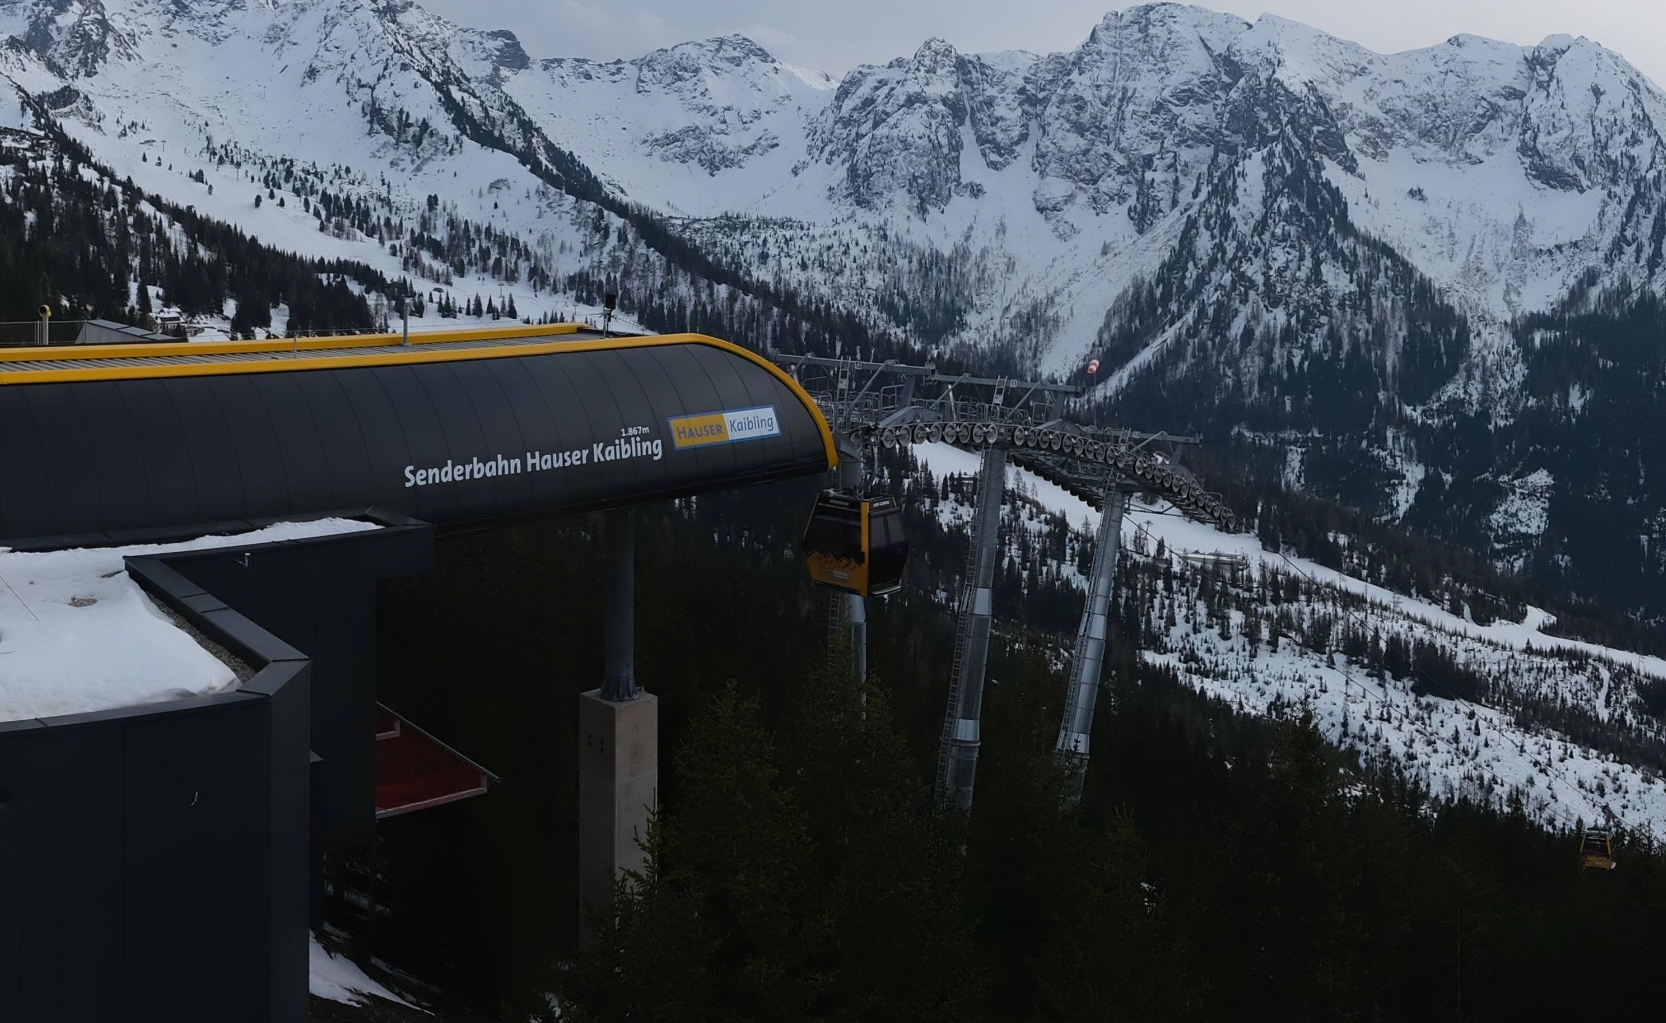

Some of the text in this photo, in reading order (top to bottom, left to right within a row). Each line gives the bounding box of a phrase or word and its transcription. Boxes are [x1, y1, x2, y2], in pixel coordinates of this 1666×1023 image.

[620, 426, 650, 437] 1.867m
[676, 415, 774, 440] HAUSER Kaibling
[404, 437, 663, 487] Senderbahn Hauser Kaibling
